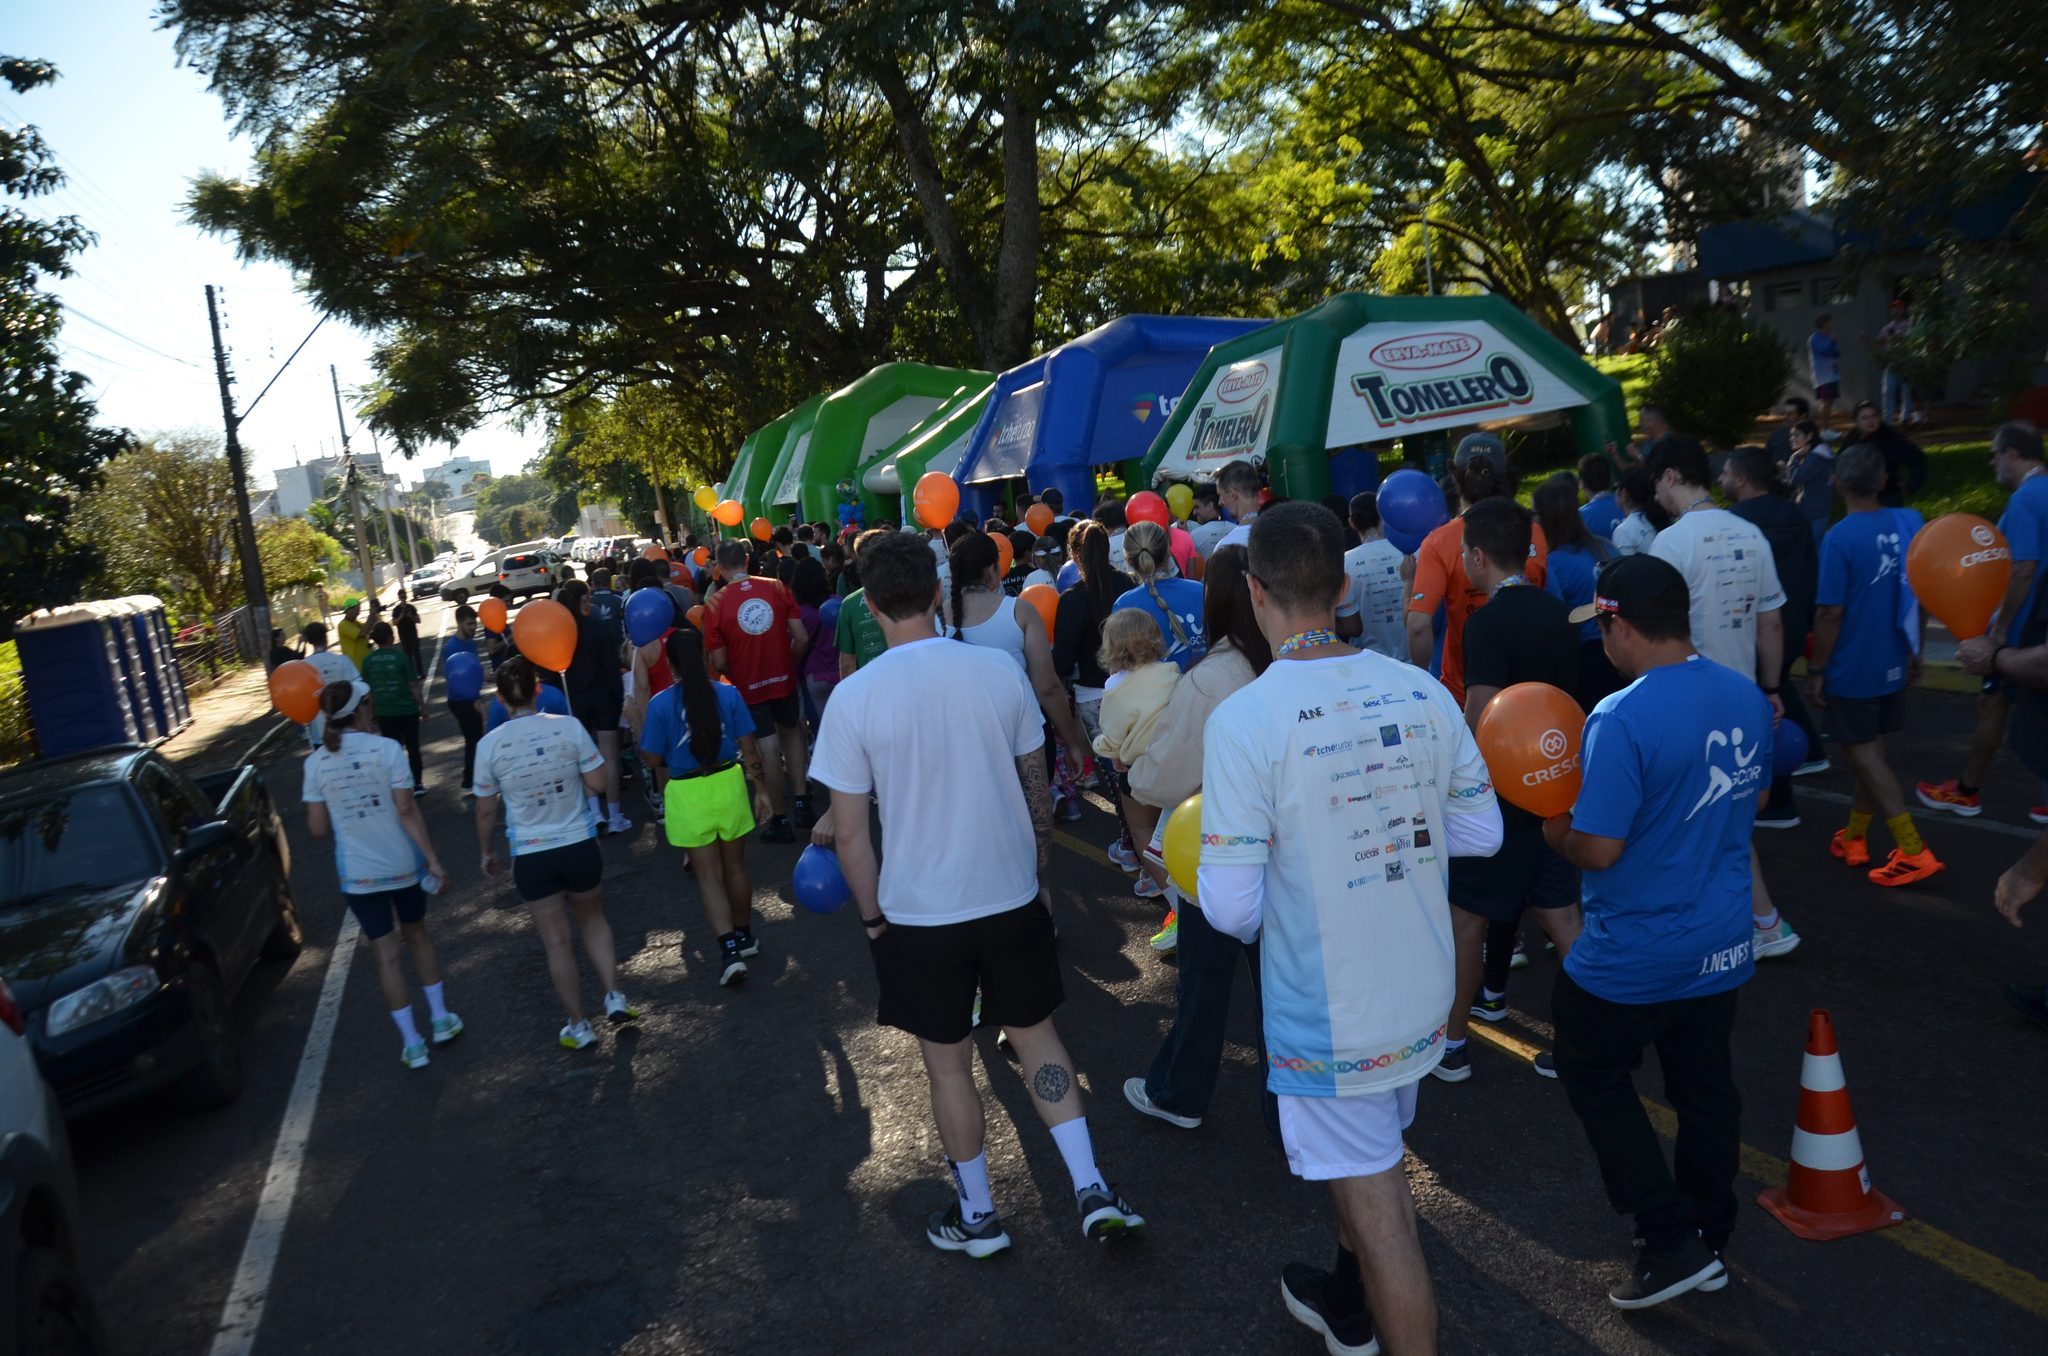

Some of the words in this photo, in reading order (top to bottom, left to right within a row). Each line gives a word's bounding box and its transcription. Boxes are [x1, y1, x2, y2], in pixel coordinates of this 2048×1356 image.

[1380, 337, 1472, 362] ERVA-MATE
[1354, 355, 1531, 422] TOMELERO
[1190, 393, 1270, 452] TOMELERO
[1298, 706, 1325, 722] ALINE
[1699, 941, 1750, 976] J.NEVES
